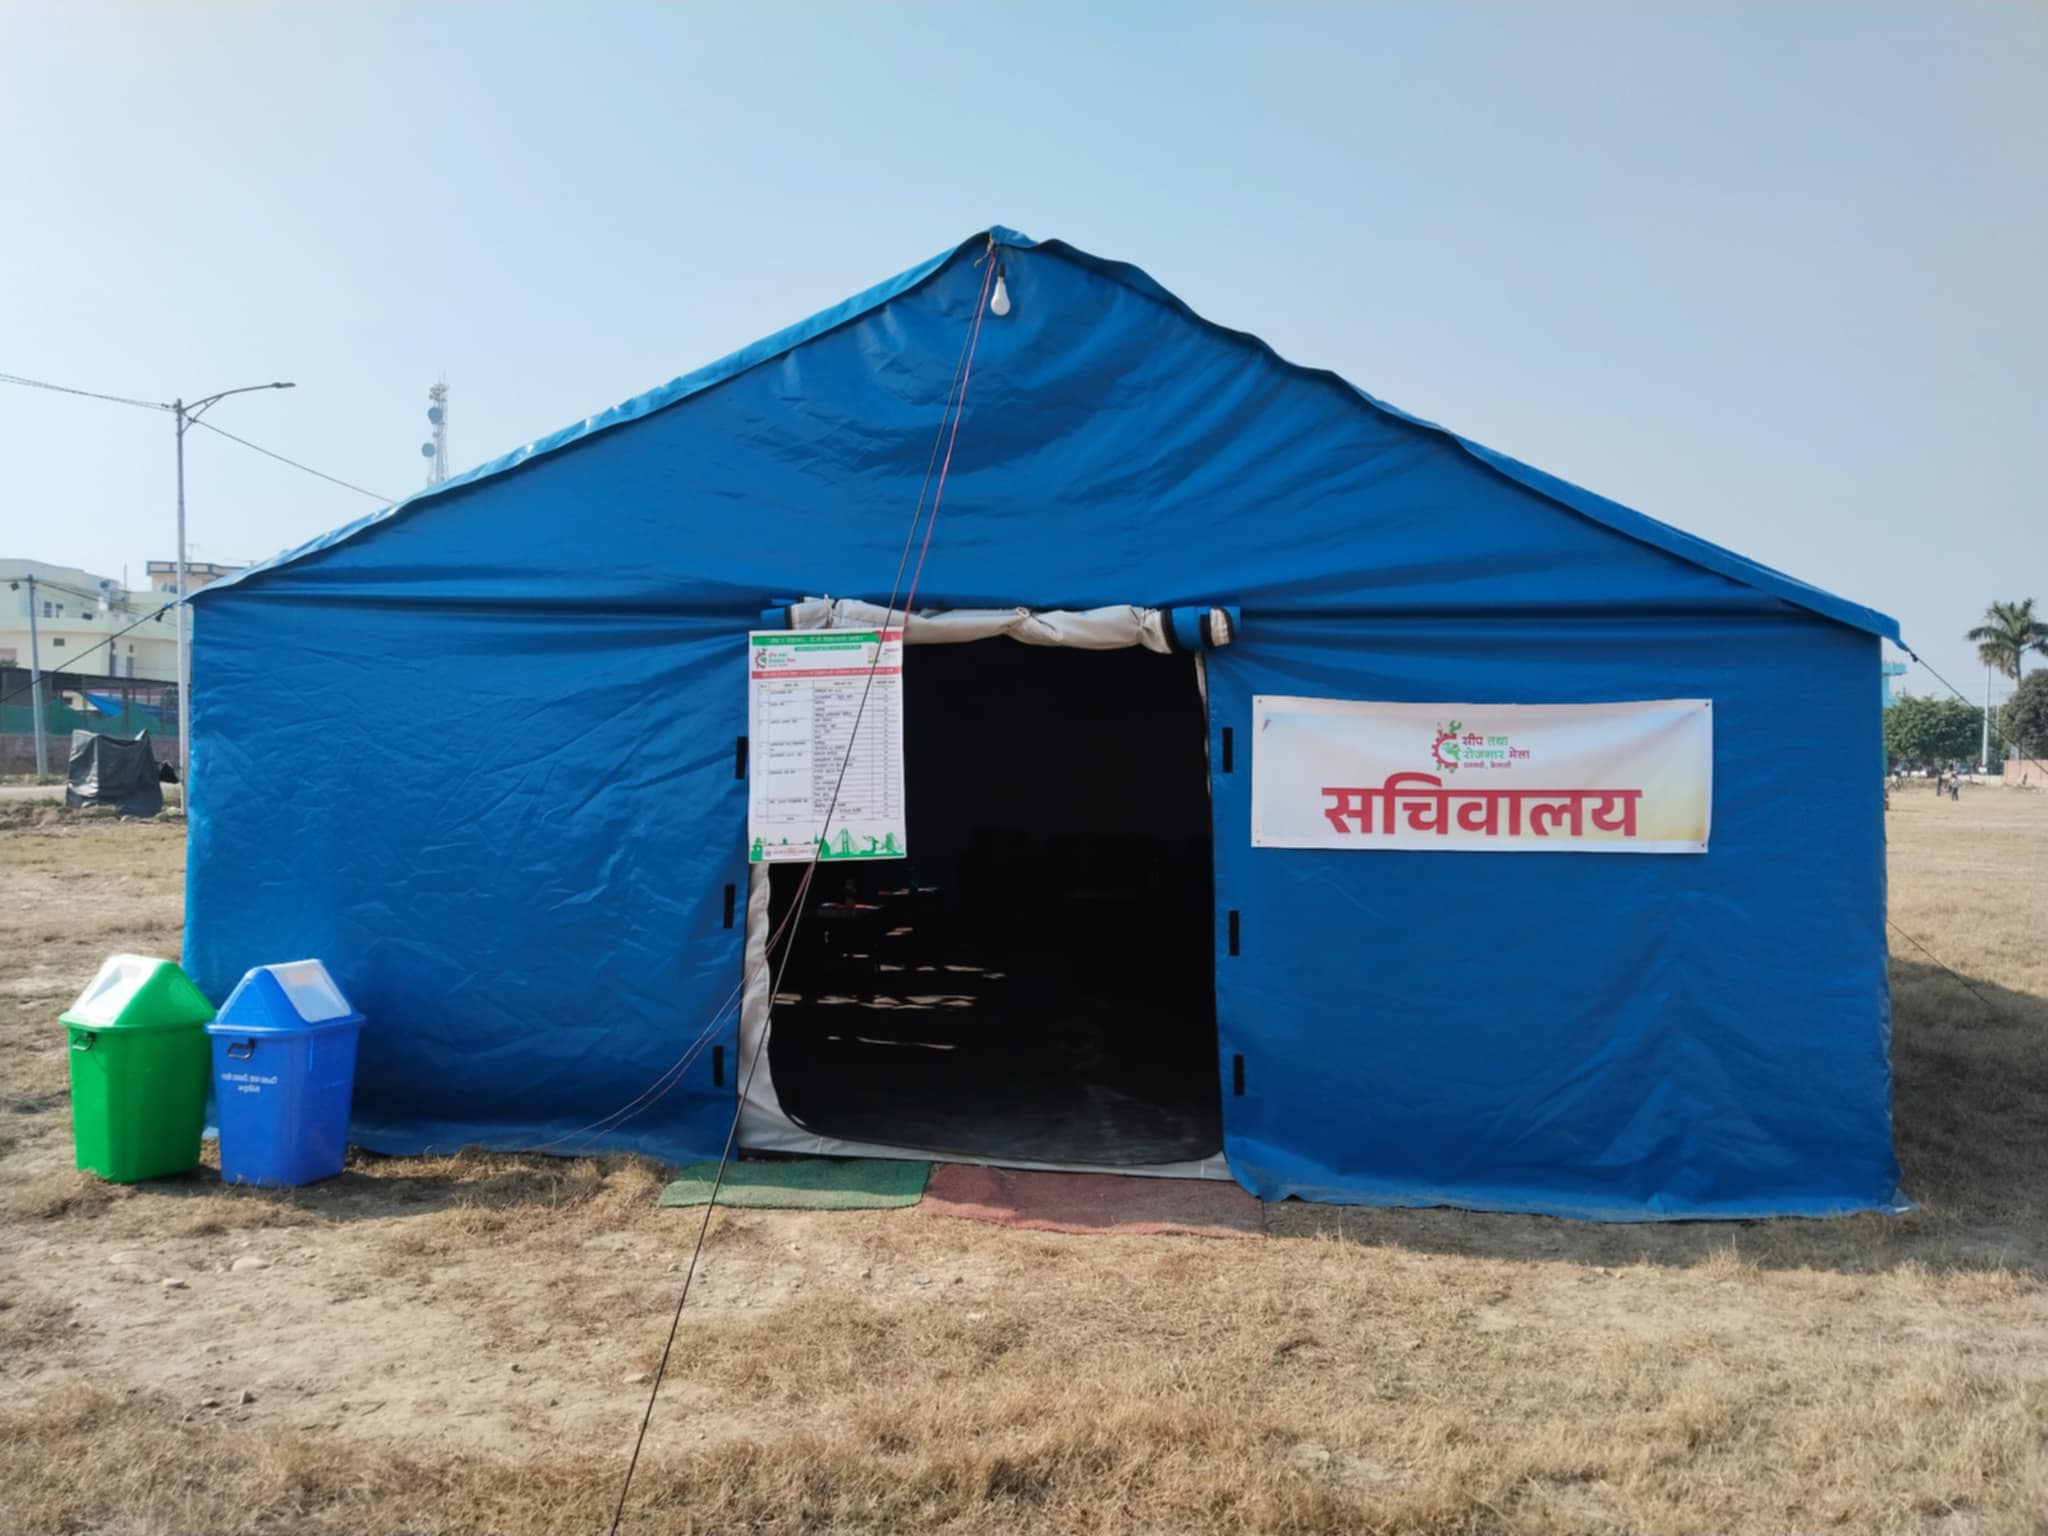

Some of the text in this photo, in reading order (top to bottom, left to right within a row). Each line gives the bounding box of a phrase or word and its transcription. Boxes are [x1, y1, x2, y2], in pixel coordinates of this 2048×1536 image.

[1486, 736, 1508, 746] तथा
[1463, 746, 1531, 759] रोजगार मेला
[1321, 771, 1643, 837] सचिवालय
